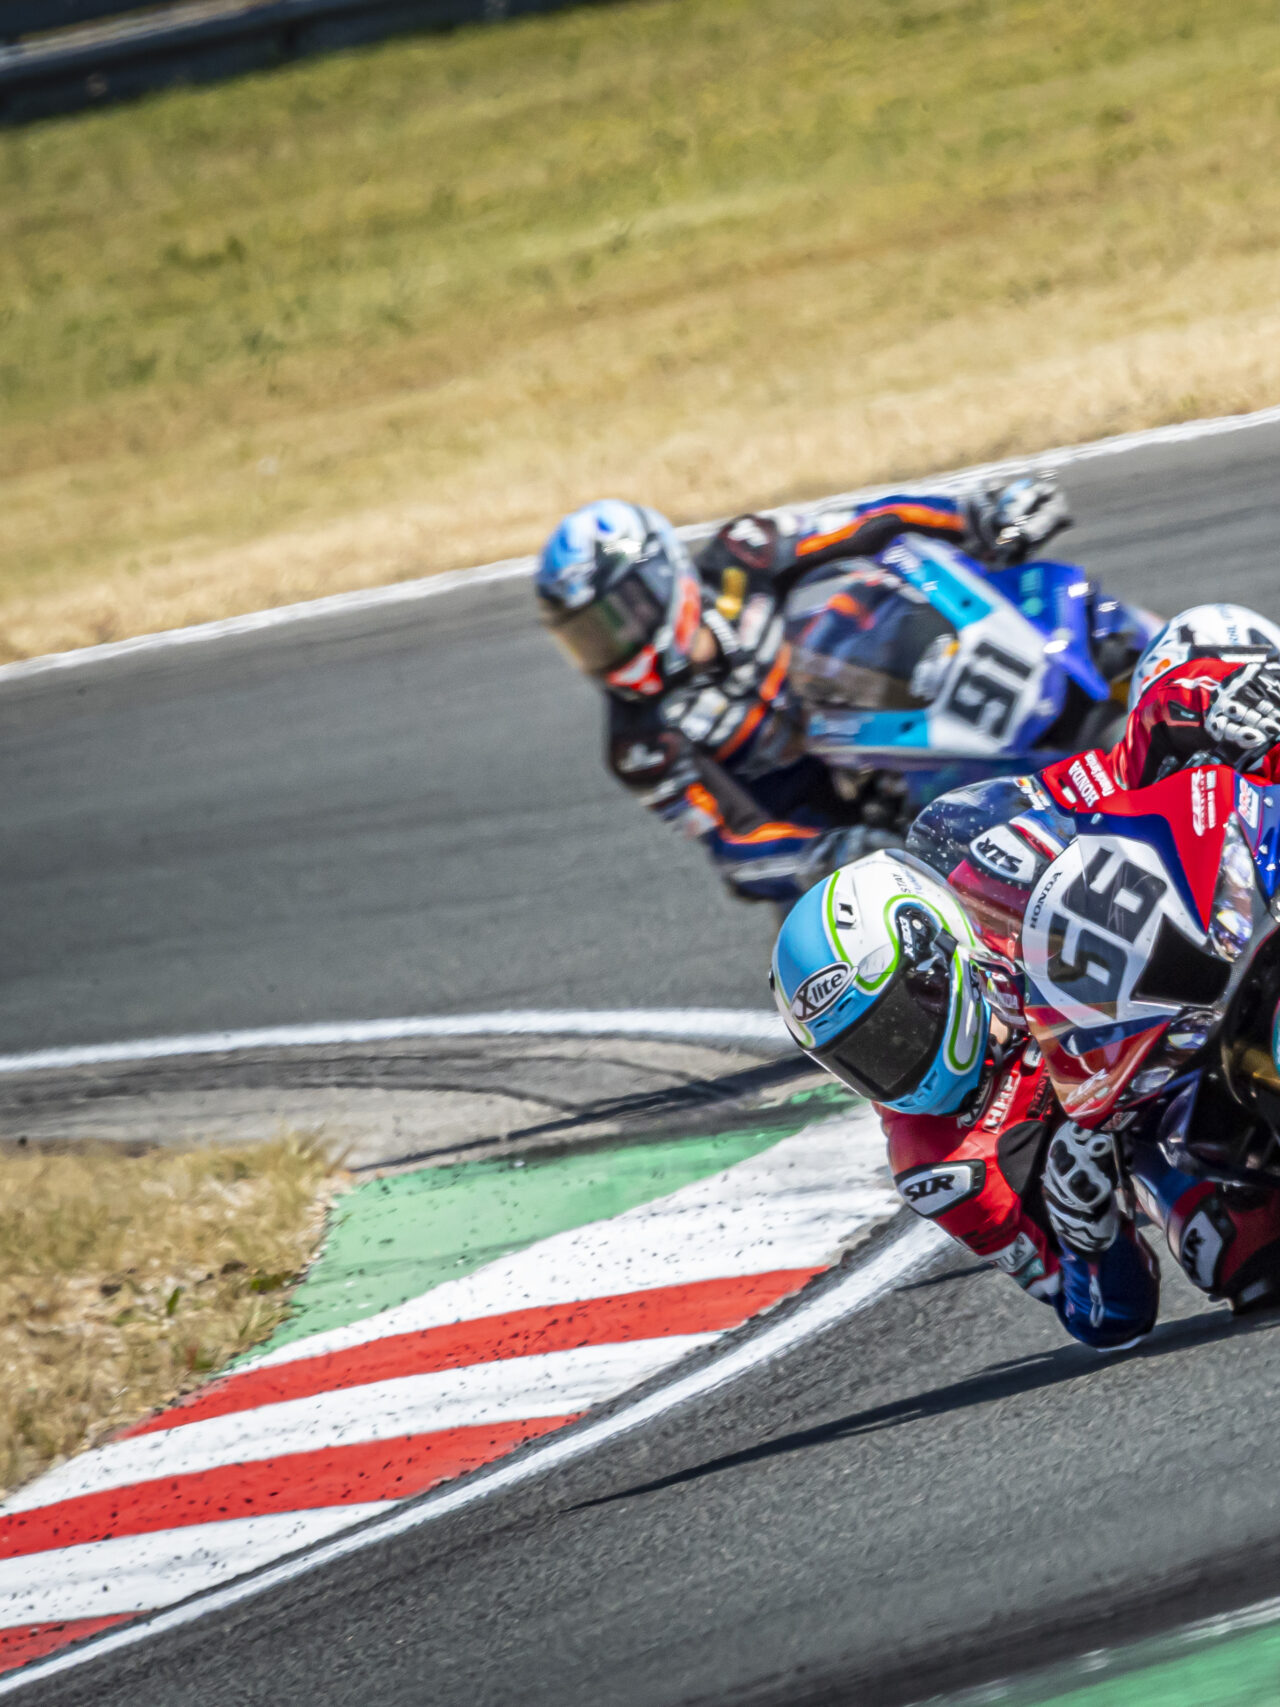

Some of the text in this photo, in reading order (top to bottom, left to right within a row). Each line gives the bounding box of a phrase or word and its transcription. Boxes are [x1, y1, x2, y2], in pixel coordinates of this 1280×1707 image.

[1068, 760, 1099, 807] HONDA
[1030, 871, 1063, 930] HONDA
[1048, 848, 1167, 1020] 66
[795, 972, 844, 1019] X-lite
